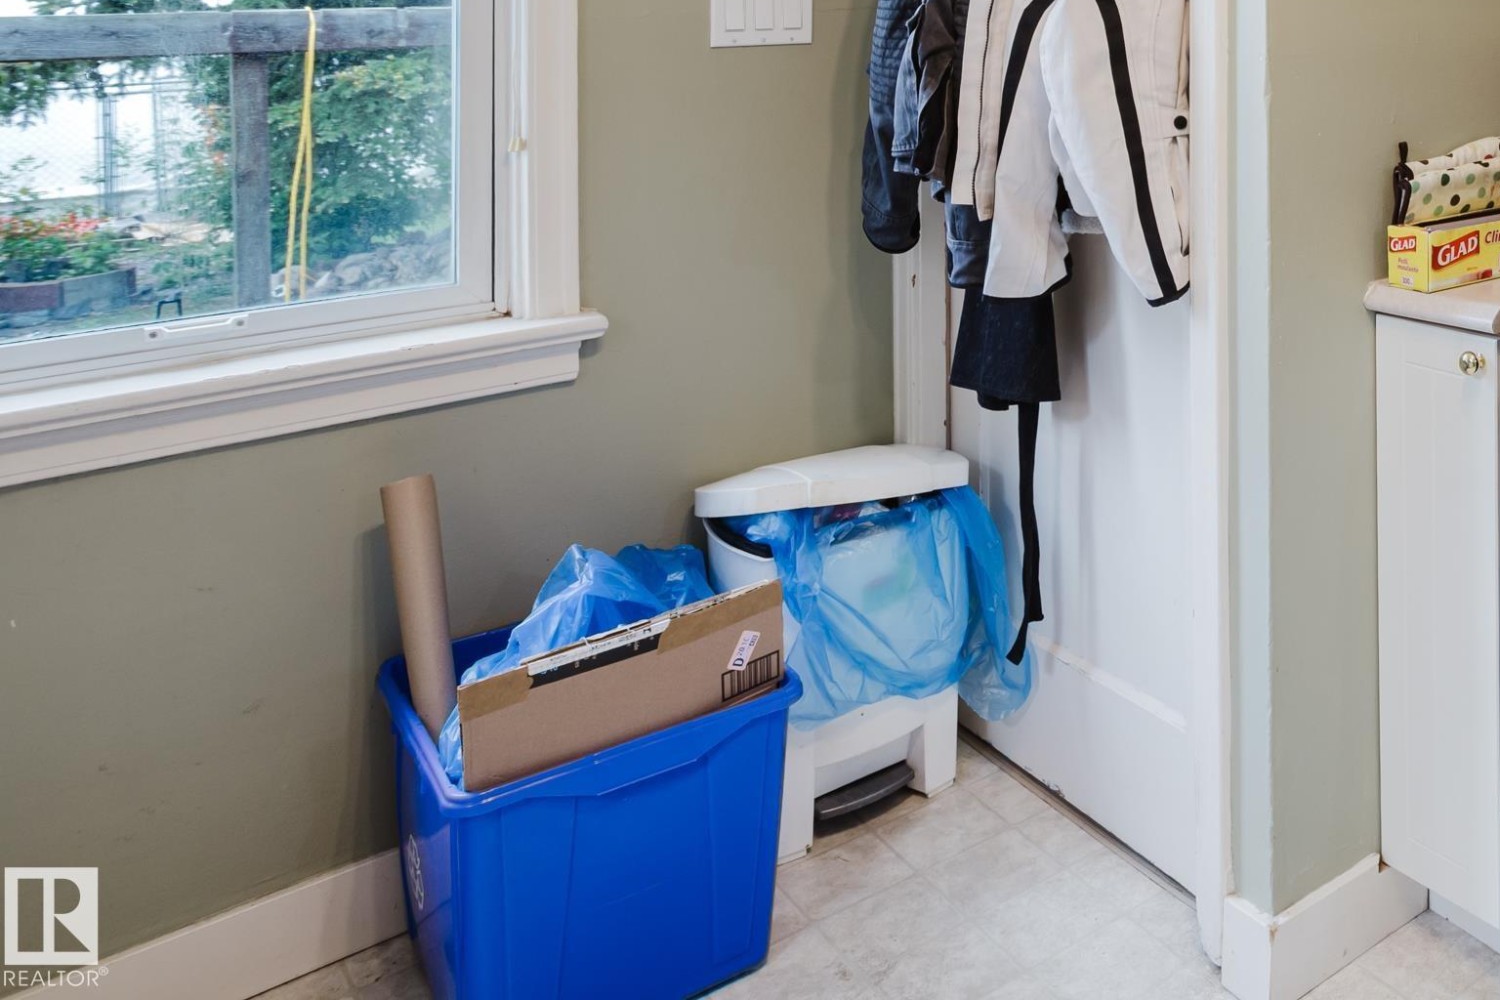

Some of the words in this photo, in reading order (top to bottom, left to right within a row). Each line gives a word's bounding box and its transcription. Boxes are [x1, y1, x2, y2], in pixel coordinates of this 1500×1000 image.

[1390, 237, 1416, 251] GLAD
[1437, 235, 1478, 267] GLAD
[732, 657, 745, 667] D
